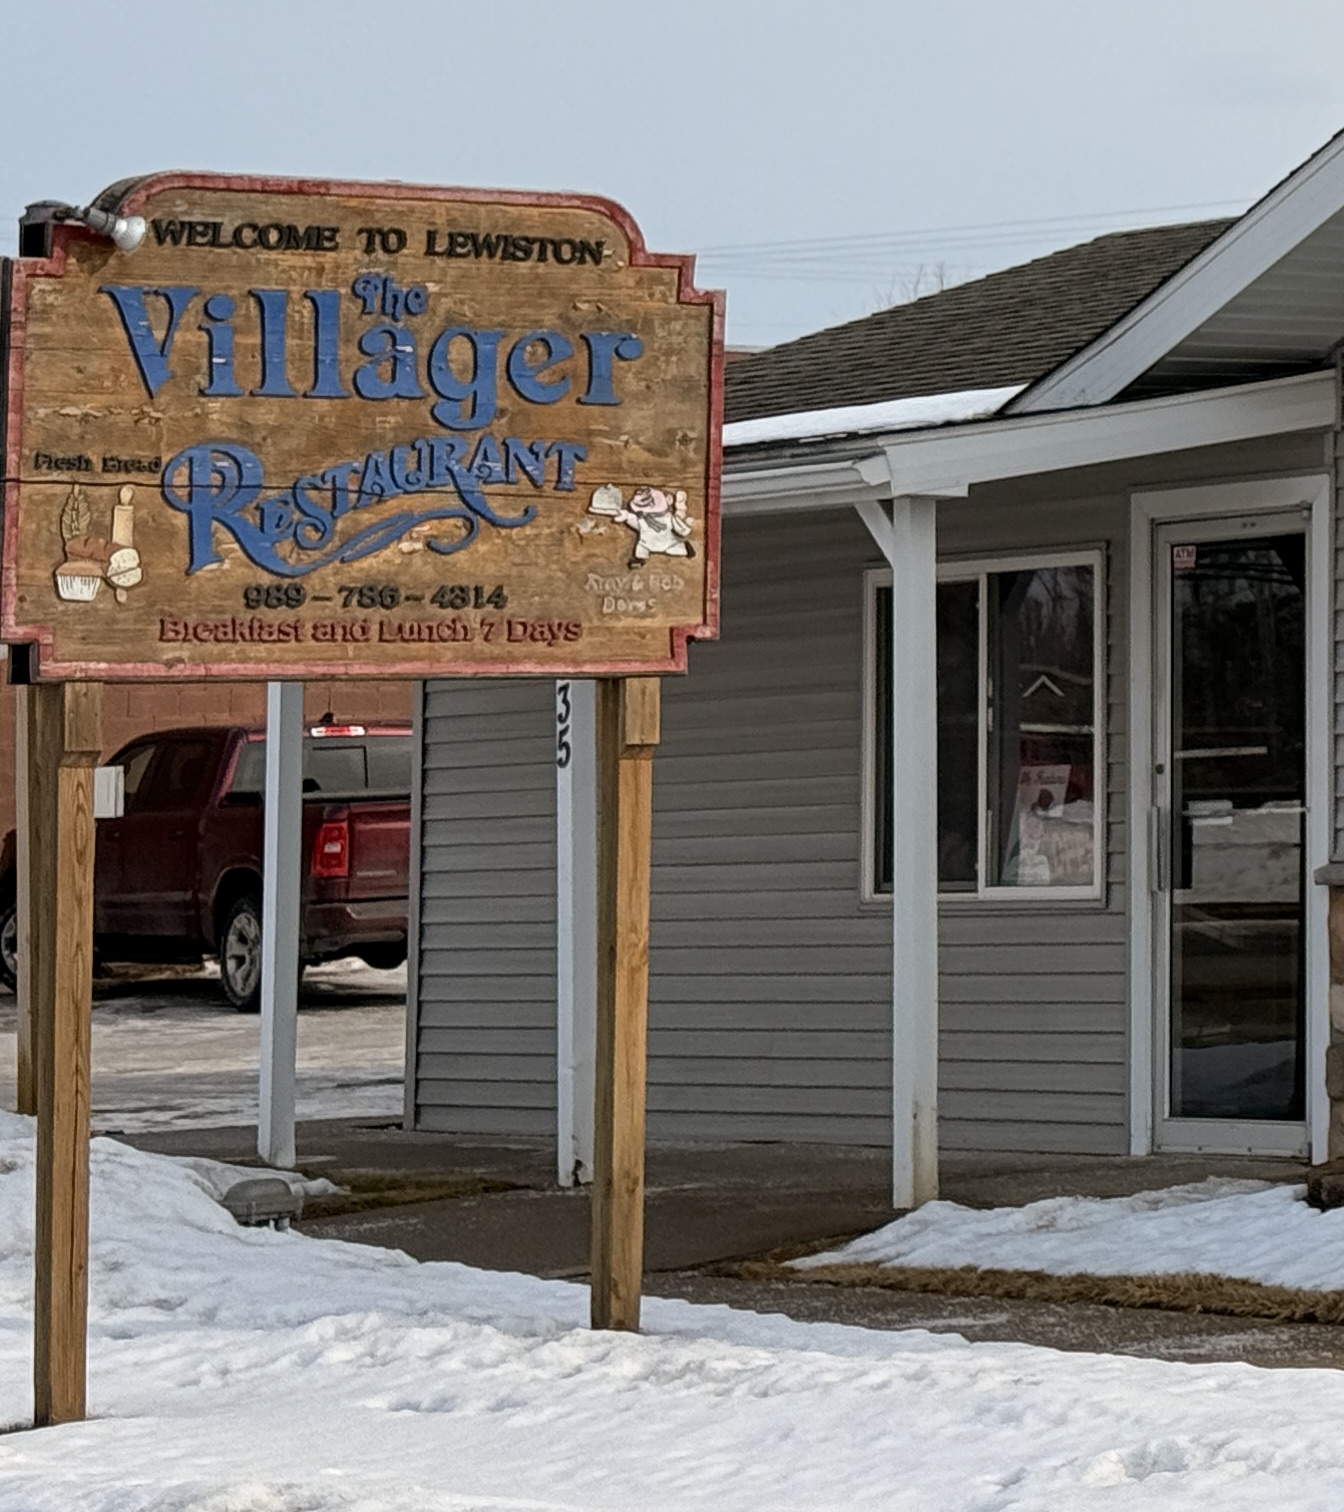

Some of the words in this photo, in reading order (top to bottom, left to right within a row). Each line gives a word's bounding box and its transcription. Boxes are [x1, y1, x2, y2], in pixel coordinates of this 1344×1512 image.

[151, 218, 339, 250] WELCOME
[357, 226, 407, 255] TO
[425, 230, 606, 266] LEWISTON
[352, 273, 428, 321] The
[98, 284, 644, 430] Villager
[159, 616, 304, 643] Breakfast
[311, 618, 370, 643] and
[379, 618, 470, 643] Lunch
[480, 619, 494, 642] 7
[506, 618, 582, 647] Days
